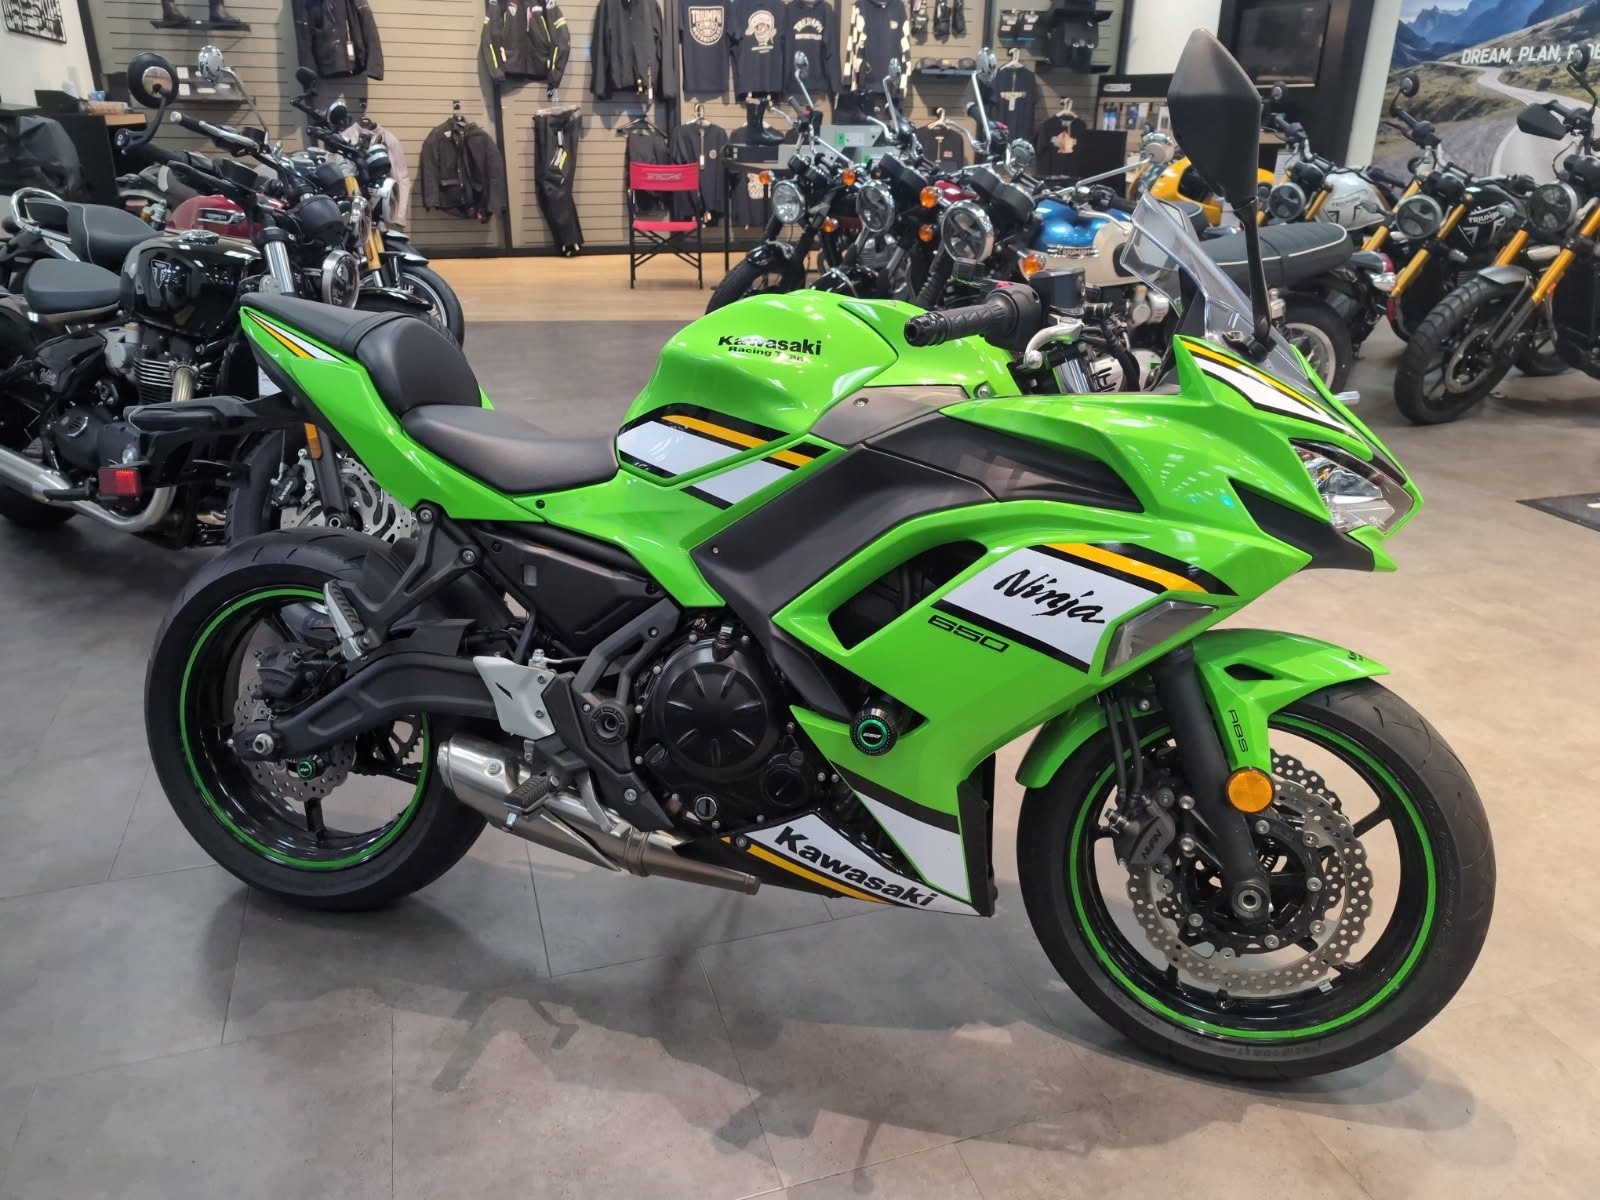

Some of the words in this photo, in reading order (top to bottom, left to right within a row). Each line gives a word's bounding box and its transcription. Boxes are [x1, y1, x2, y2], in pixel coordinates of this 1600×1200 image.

[1461, 47, 1513, 64] DREAM,
[1518, 44, 1561, 62] PLAN,
[718, 335, 822, 355] Kawasaki
[728, 346, 772, 357] Racing
[993, 569, 1105, 624] Ninja
[928, 614, 1010, 653] 650
[1228, 709, 1249, 753] ABS
[774, 826, 938, 907] Kawasaki
